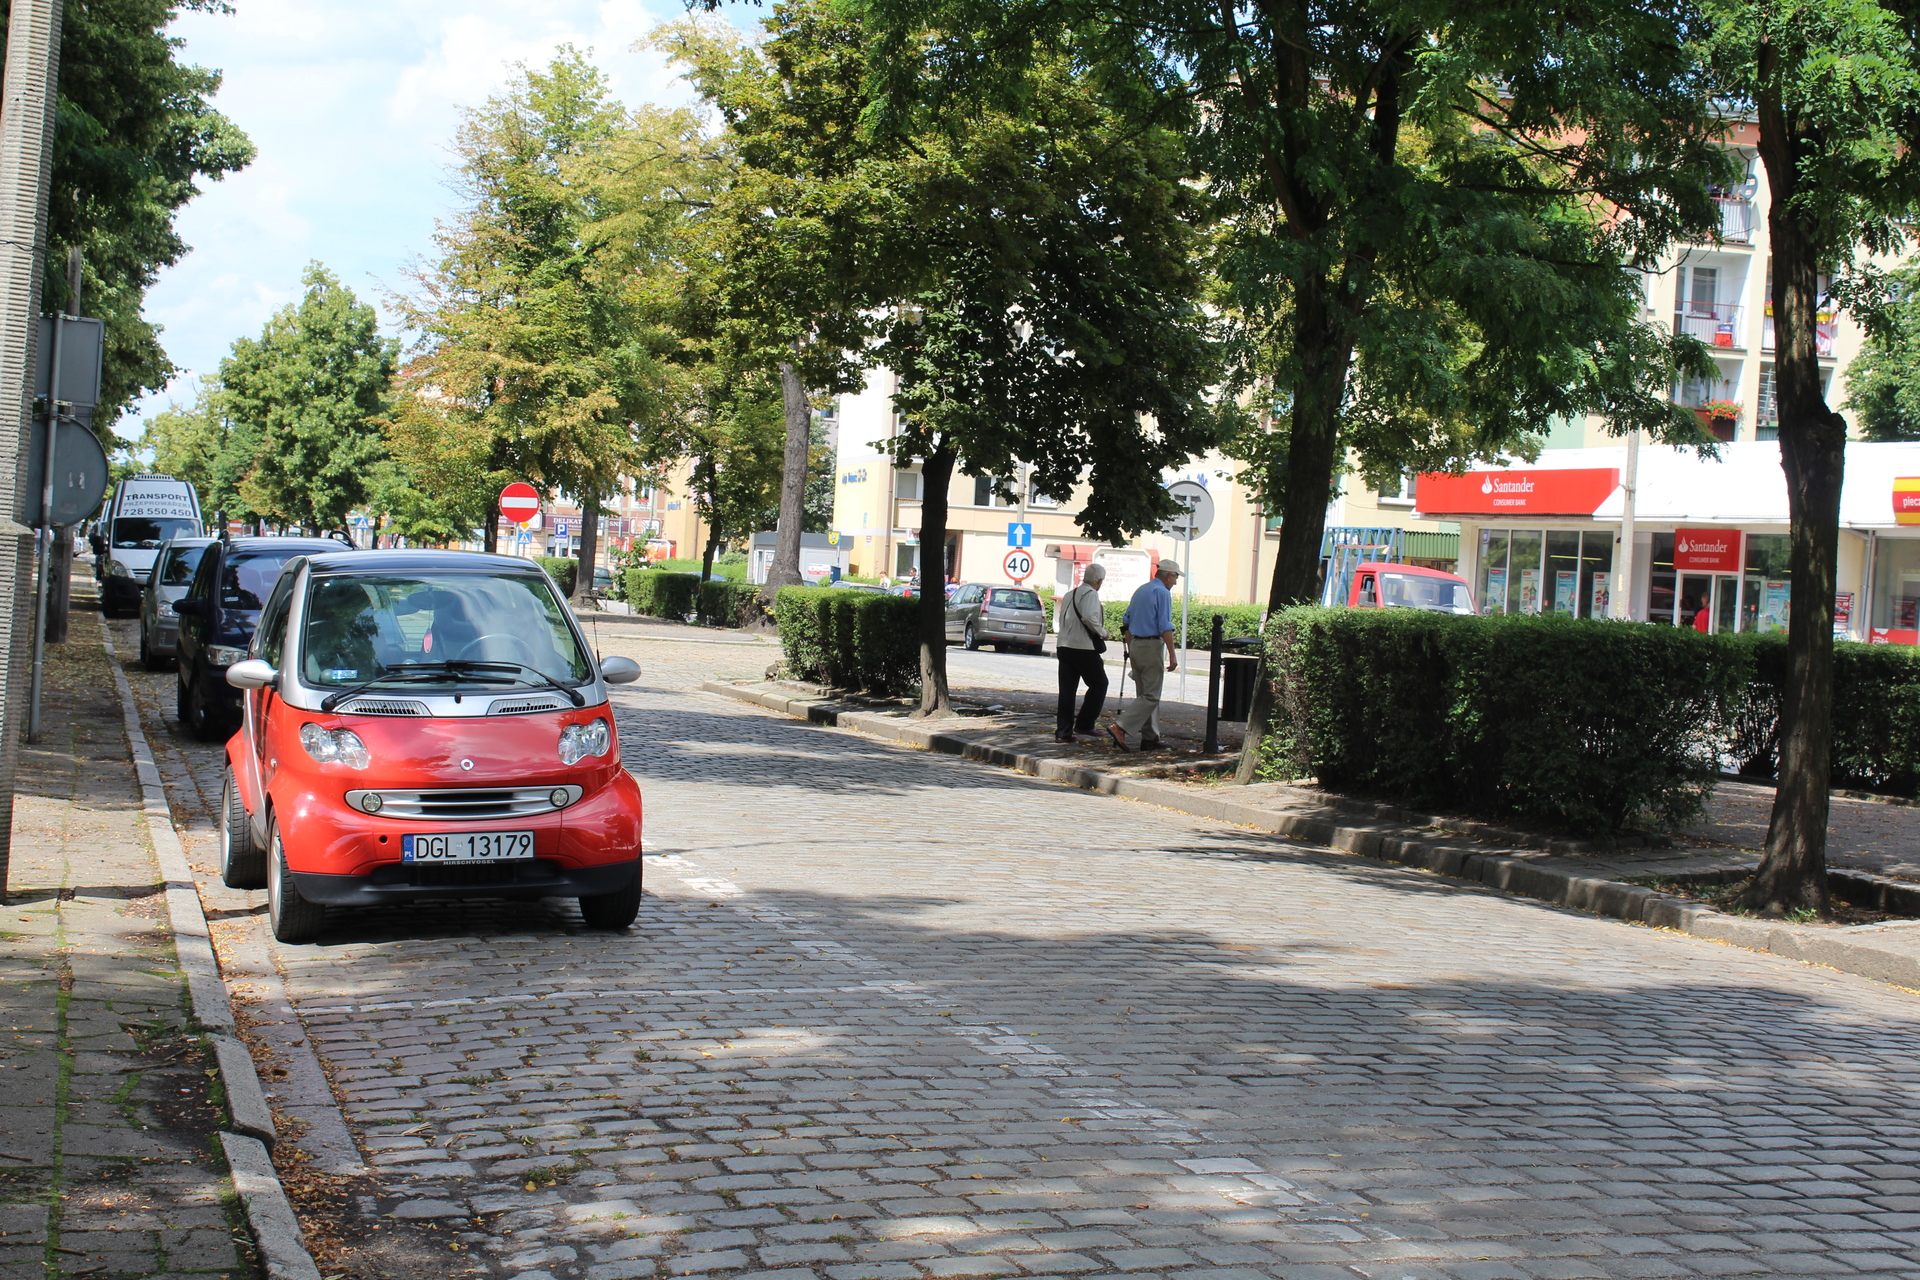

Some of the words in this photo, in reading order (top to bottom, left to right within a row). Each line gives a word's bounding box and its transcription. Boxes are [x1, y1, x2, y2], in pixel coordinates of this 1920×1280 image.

[1493, 476, 1535, 493] Santander
[1493, 498, 1515, 506] CONSUMER
[1515, 498, 1527, 506] BANK
[1903, 496, 1920, 509] piec
[1689, 539, 1728, 553] Santander
[1007, 557, 1030, 573] 40
[416, 837, 457, 858] DGL
[468, 834, 531, 857] 13179
